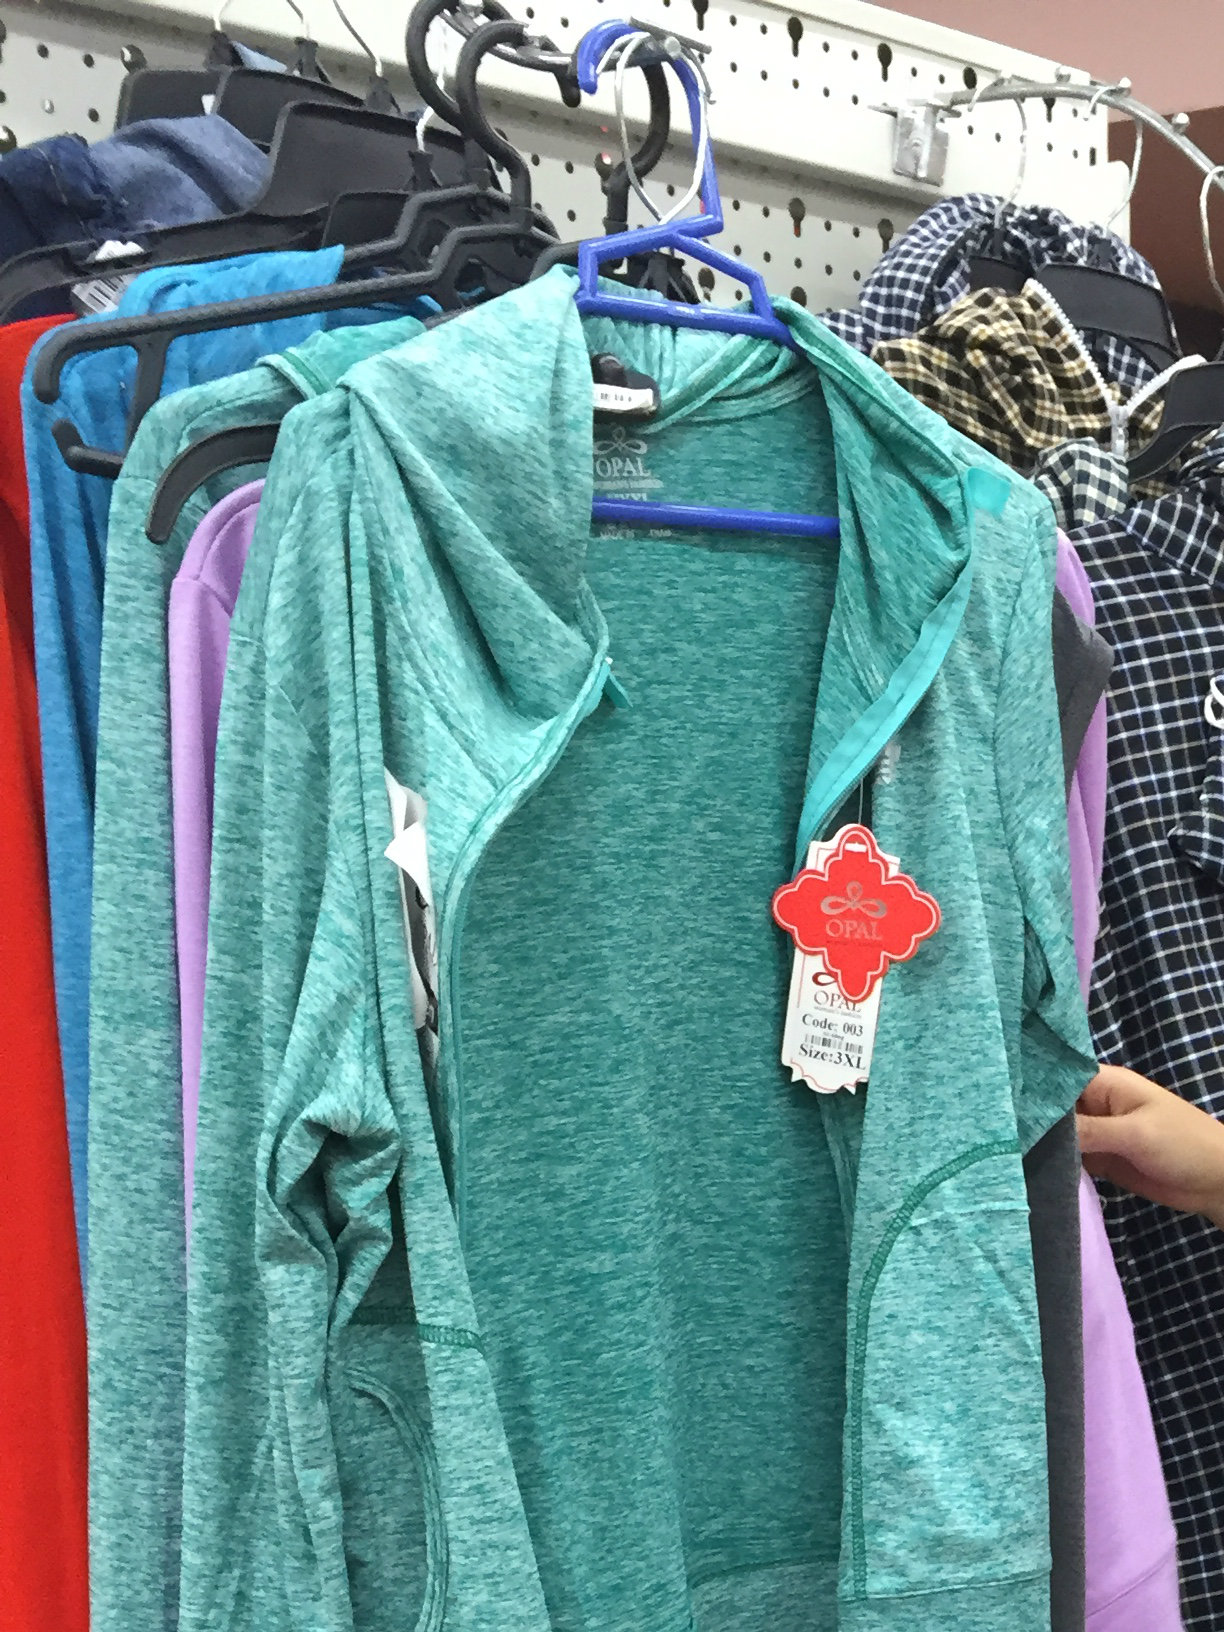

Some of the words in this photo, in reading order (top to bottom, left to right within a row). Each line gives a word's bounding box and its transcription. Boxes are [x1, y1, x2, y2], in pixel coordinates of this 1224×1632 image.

[596, 457, 651, 478] OPAL
[826, 918, 882, 940] OPAL
[802, 1013, 838, 1032] Code:
[843, 1022, 863, 1037] 003
